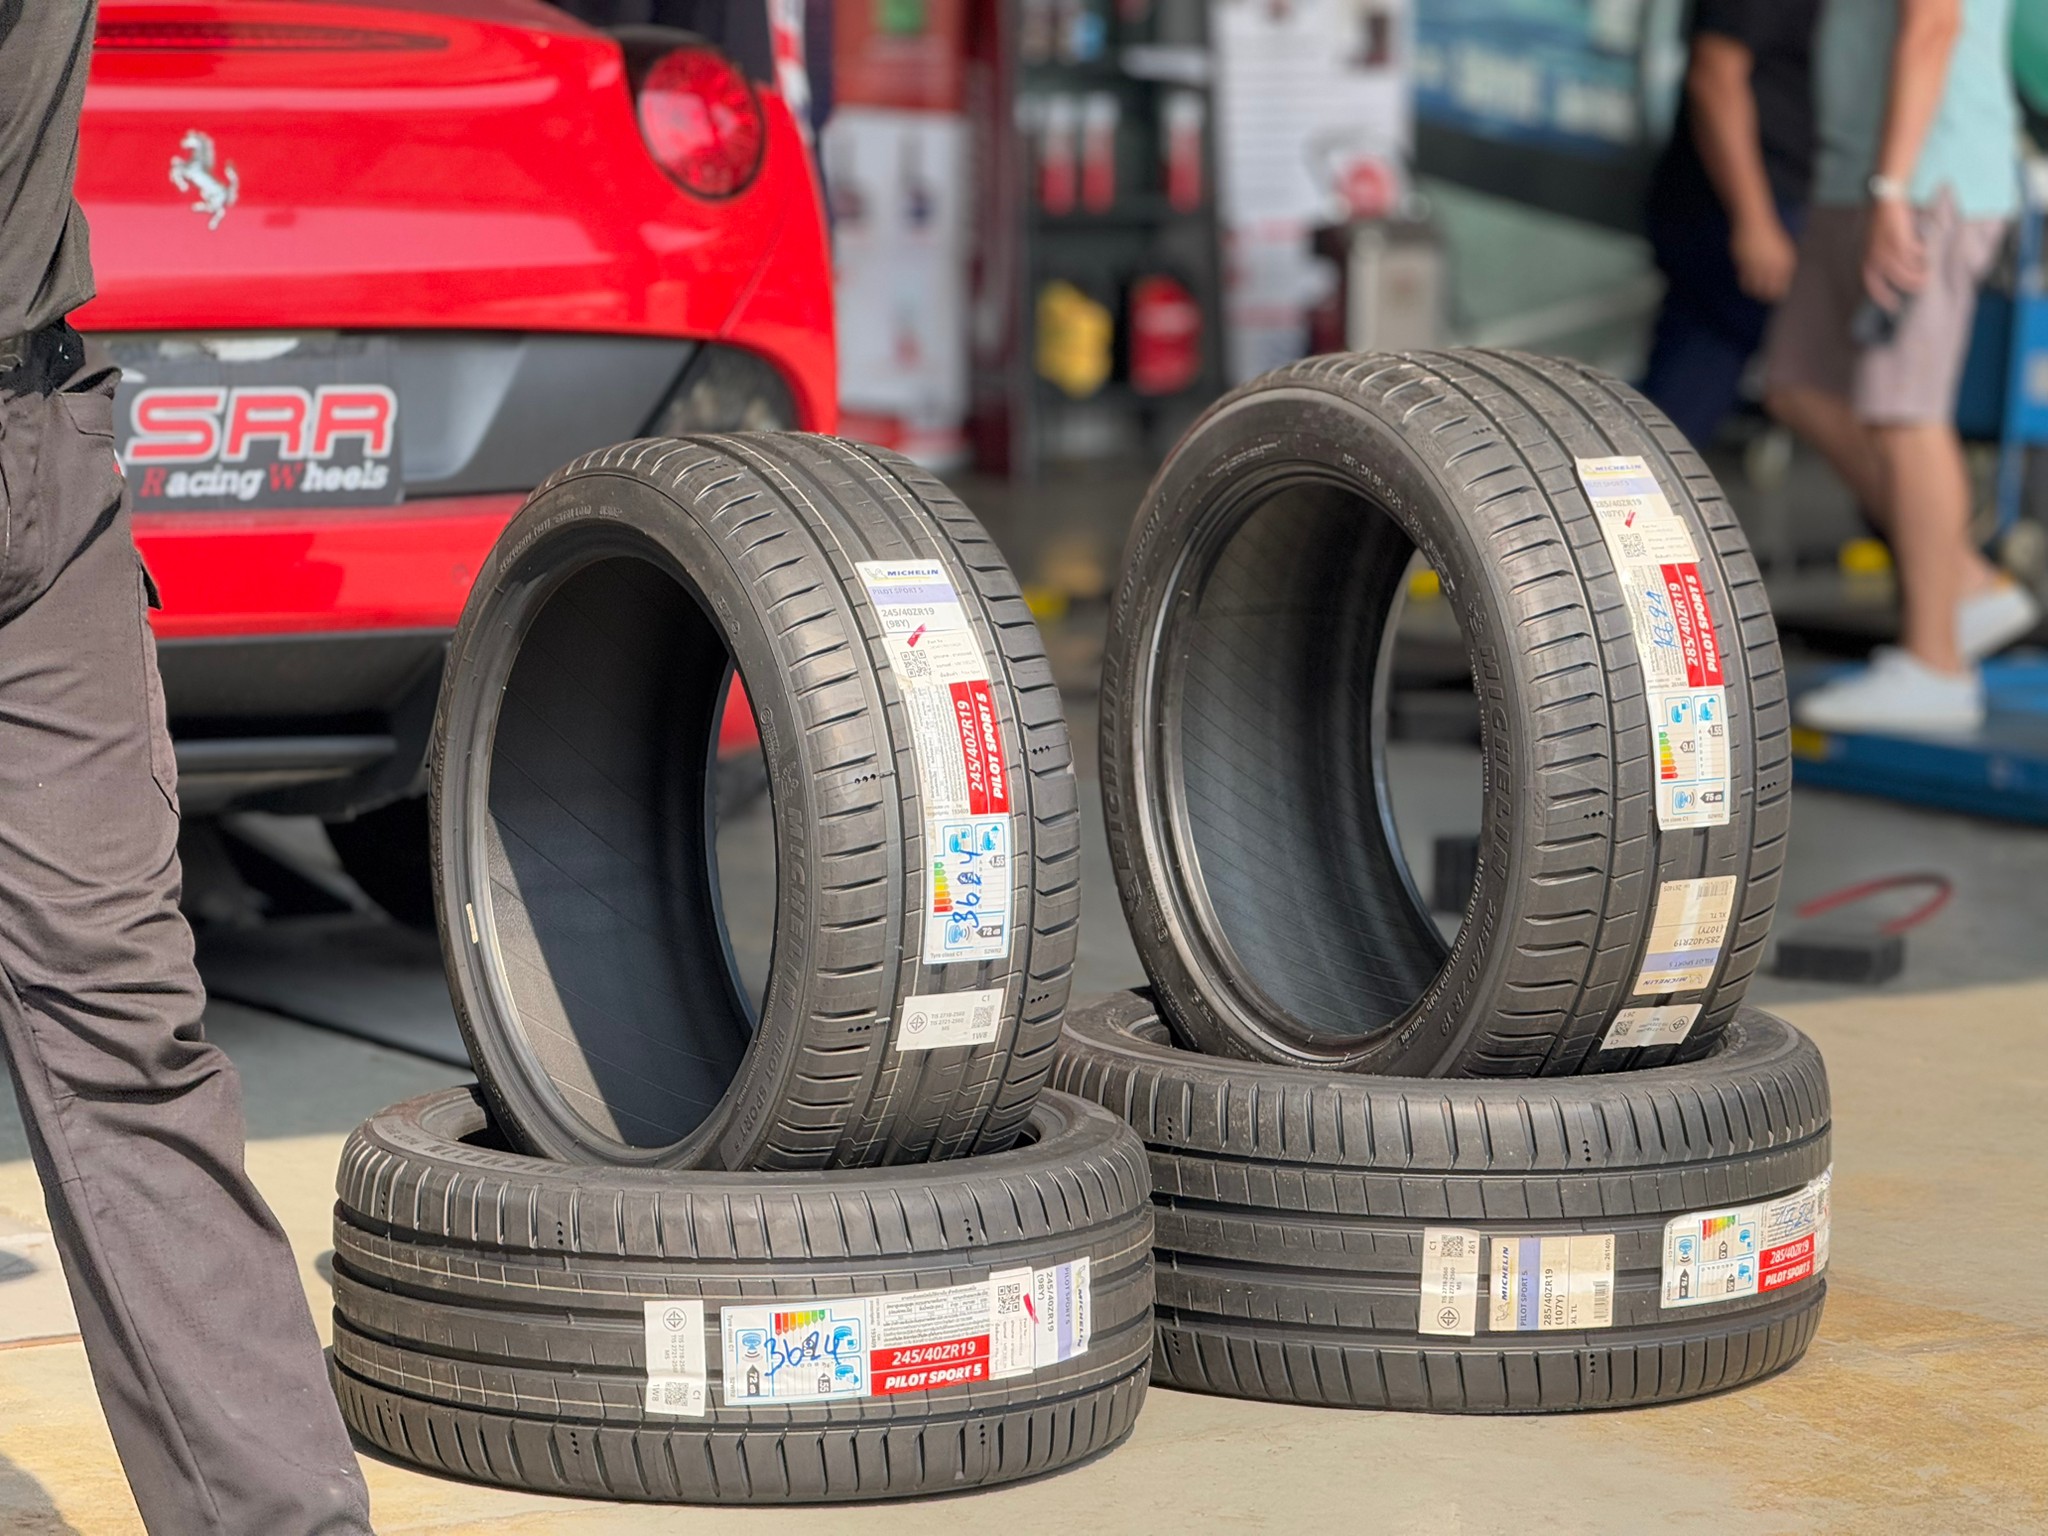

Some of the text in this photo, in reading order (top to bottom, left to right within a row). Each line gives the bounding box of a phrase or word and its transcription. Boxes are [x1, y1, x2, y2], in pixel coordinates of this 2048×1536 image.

[1594, 464, 1642, 472] MICHELIN
[140, 459, 390, 500] Racing Wheels
[1594, 499, 1642, 508] 285/40ZR19
[1599, 510, 1626, 519] (107Y)
[887, 569, 939, 577] MICHELIN
[895, 587, 918, 595] SPORT
[881, 607, 934, 617] 245/40ZR19
[1114, 571, 1134, 636] PILOT
[885, 619, 910, 629] (98Y)
[1668, 582, 1699, 667] 285/40ZR19
[1685, 574, 1718, 673] PILOT SPORT 5
[1710, 726, 1722, 736] 1.55
[957, 700, 984, 792] 245/40ZR19
[975, 692, 1004, 799] PILOT SPORT 5
[1682, 742, 1695, 752] 9.0
[1102, 654, 1130, 871] MICHELIN
[1480, 646, 1512, 879] MICHELIN
[1705, 793, 1714, 801] 75
[991, 855, 1005, 867] 1.55
[781, 807, 806, 1010] MICHELIN
[982, 927, 992, 936] 72
[1698, 925, 1723, 934] (107Y)
[1673, 936, 1720, 947] 285/40ZR19
[1643, 976, 1688, 986] MICHELIN
[1623, 1010, 1636, 1018] 261
[972, 1031, 988, 1040] 1W8
[763, 1025, 788, 1085] PILOT
[740, 1085, 768, 1141] SPORT
[1429, 1240, 1437, 1250] C1
[1468, 1240, 1476, 1254] 261
[1770, 1241, 1810, 1266] 285/40ZR19
[1501, 1246, 1509, 1301] MICHELIN
[1682, 1276, 1689, 1288] 75
[1764, 1270, 1787, 1287] PILOT
[1786, 1262, 1806, 1280] SPORT
[1727, 1275, 1735, 1292] 1.55
[1046, 1272, 1054, 1332] 245/40ZR19
[1543, 1268, 1554, 1326] 285/40ZR19
[1076, 1288, 1084, 1348] MICHELIN
[1555, 1294, 1565, 1326] (107Y)
[1570, 1303, 1577, 1325] XL TL
[892, 1341, 976, 1366] 245/40ZR19
[750, 1372, 758, 1384] 72
[819, 1376, 829, 1393] 1.55
[885, 1363, 982, 1390] PILOT SPORT 5
[651, 1383, 660, 1402] 1W8
[692, 1390, 701, 1400] C1
